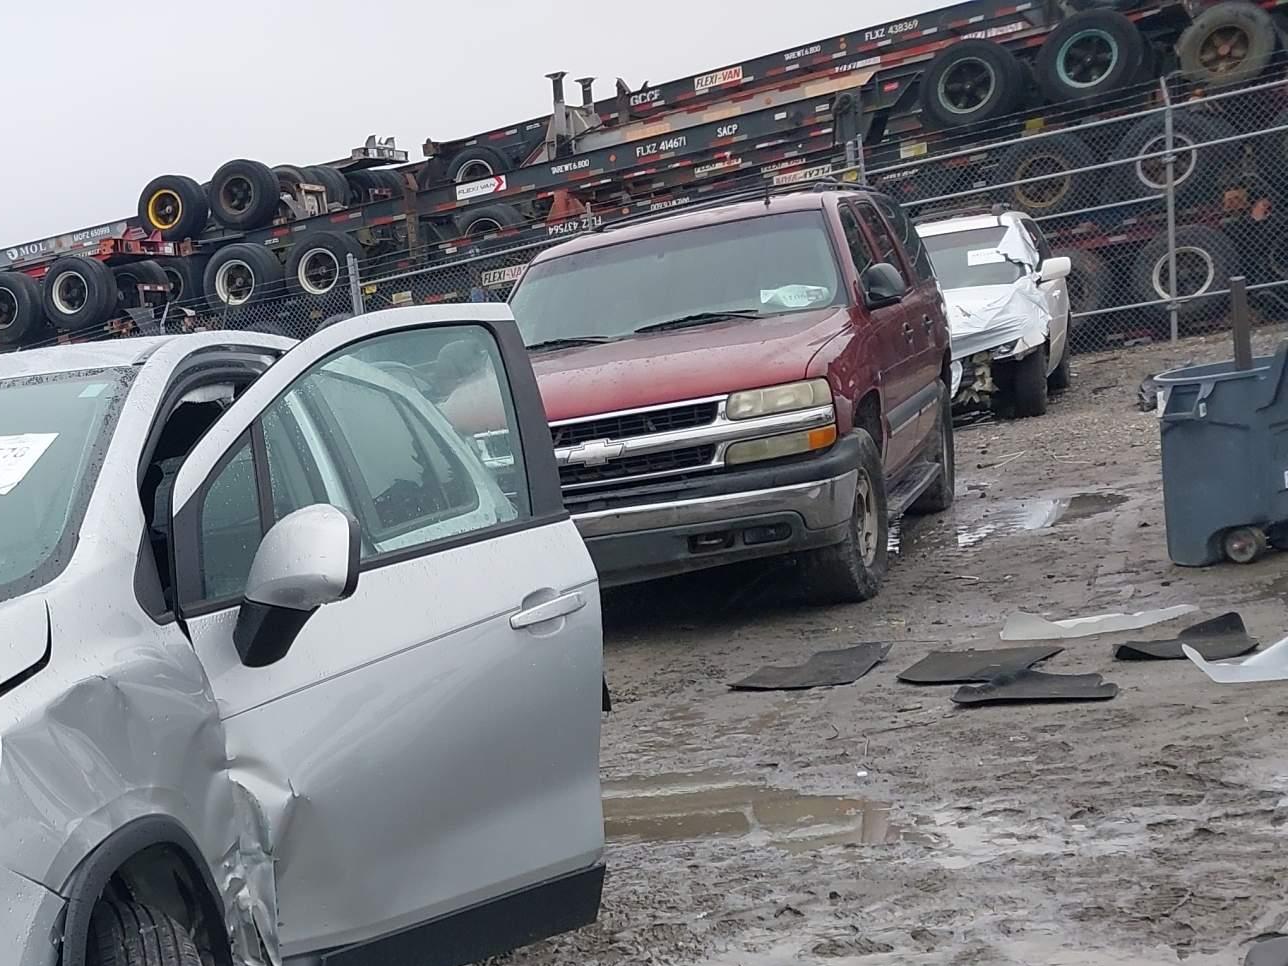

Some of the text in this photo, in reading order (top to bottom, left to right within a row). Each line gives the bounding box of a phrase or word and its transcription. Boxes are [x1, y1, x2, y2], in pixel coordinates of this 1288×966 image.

[864, 19, 919, 42] FLXZ 438369
[695, 67, 741, 90] FLEXI-VAN
[716, 124, 738, 137] SACP
[636, 136, 687, 157] FLXZ 414671
[548, 219, 579, 236] 437564
[19, 242, 47, 257] MOL
